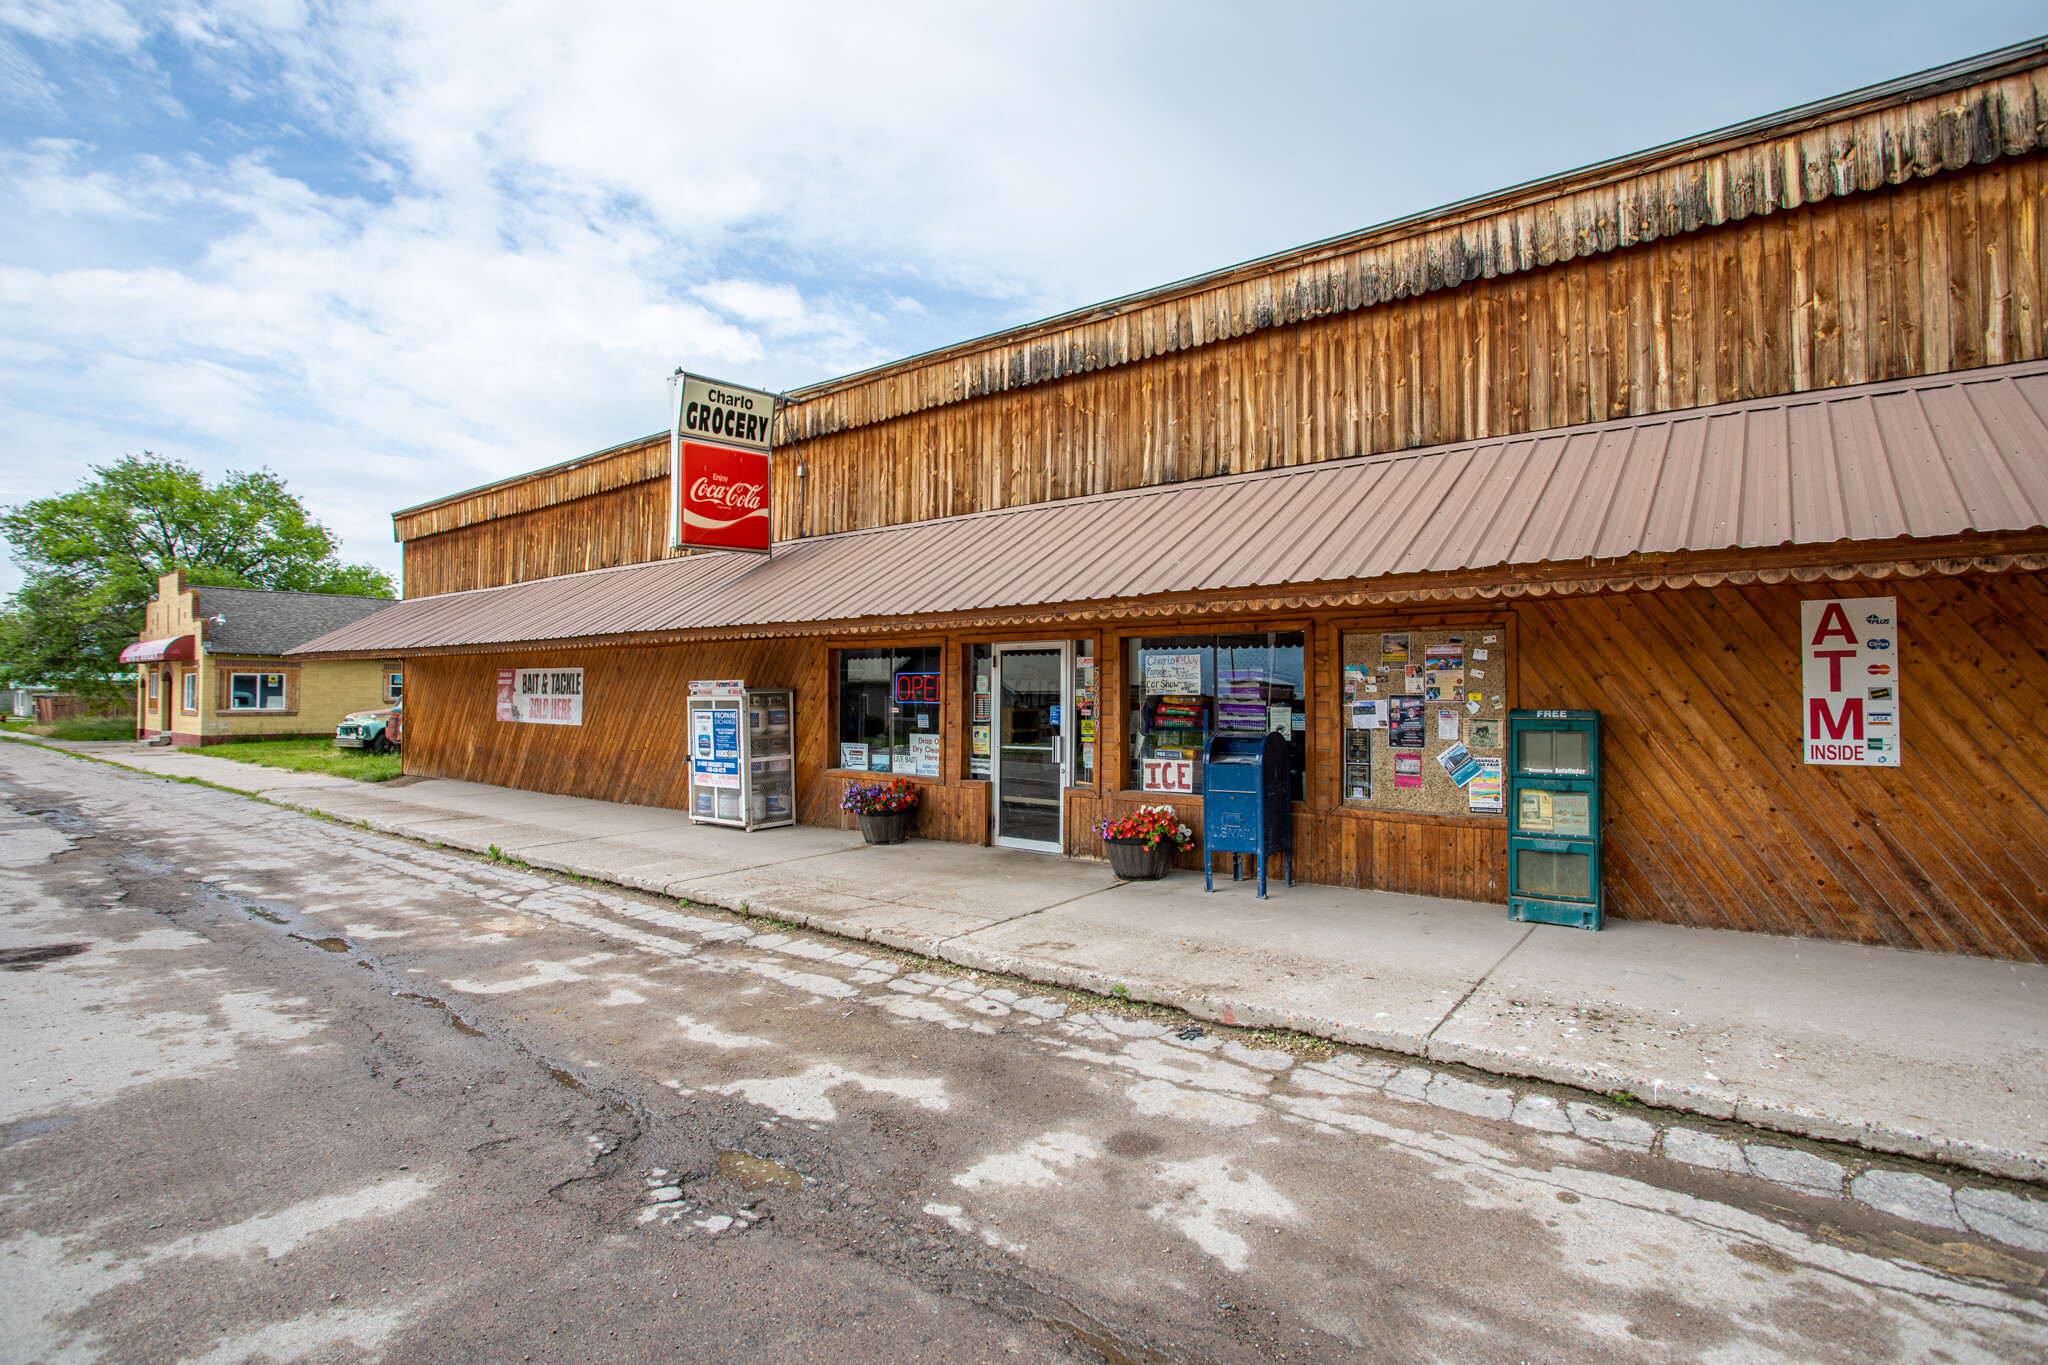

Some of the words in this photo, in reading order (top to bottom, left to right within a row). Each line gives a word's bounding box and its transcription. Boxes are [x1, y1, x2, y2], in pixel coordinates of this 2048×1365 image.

[708, 388, 754, 410] Charlo
[686, 401, 769, 442] GROCERY
[712, 474, 728, 482] Enjoy
[690, 476, 763, 509] Coca-Cola
[1147, 655, 1175, 666] Charlo
[1147, 667, 1166, 676] Parade
[522, 674, 539, 694] BAIT
[542, 673, 548, 694] &
[551, 673, 581, 694] TACKLE
[1161, 680, 1179, 688] Show
[529, 698, 548, 719] SOLD
[551, 698, 572, 720] HERE
[913, 746, 923, 754] Dry
[1810, 745, 1864, 760] INSIDE
[1145, 762, 1190, 789] ICE
